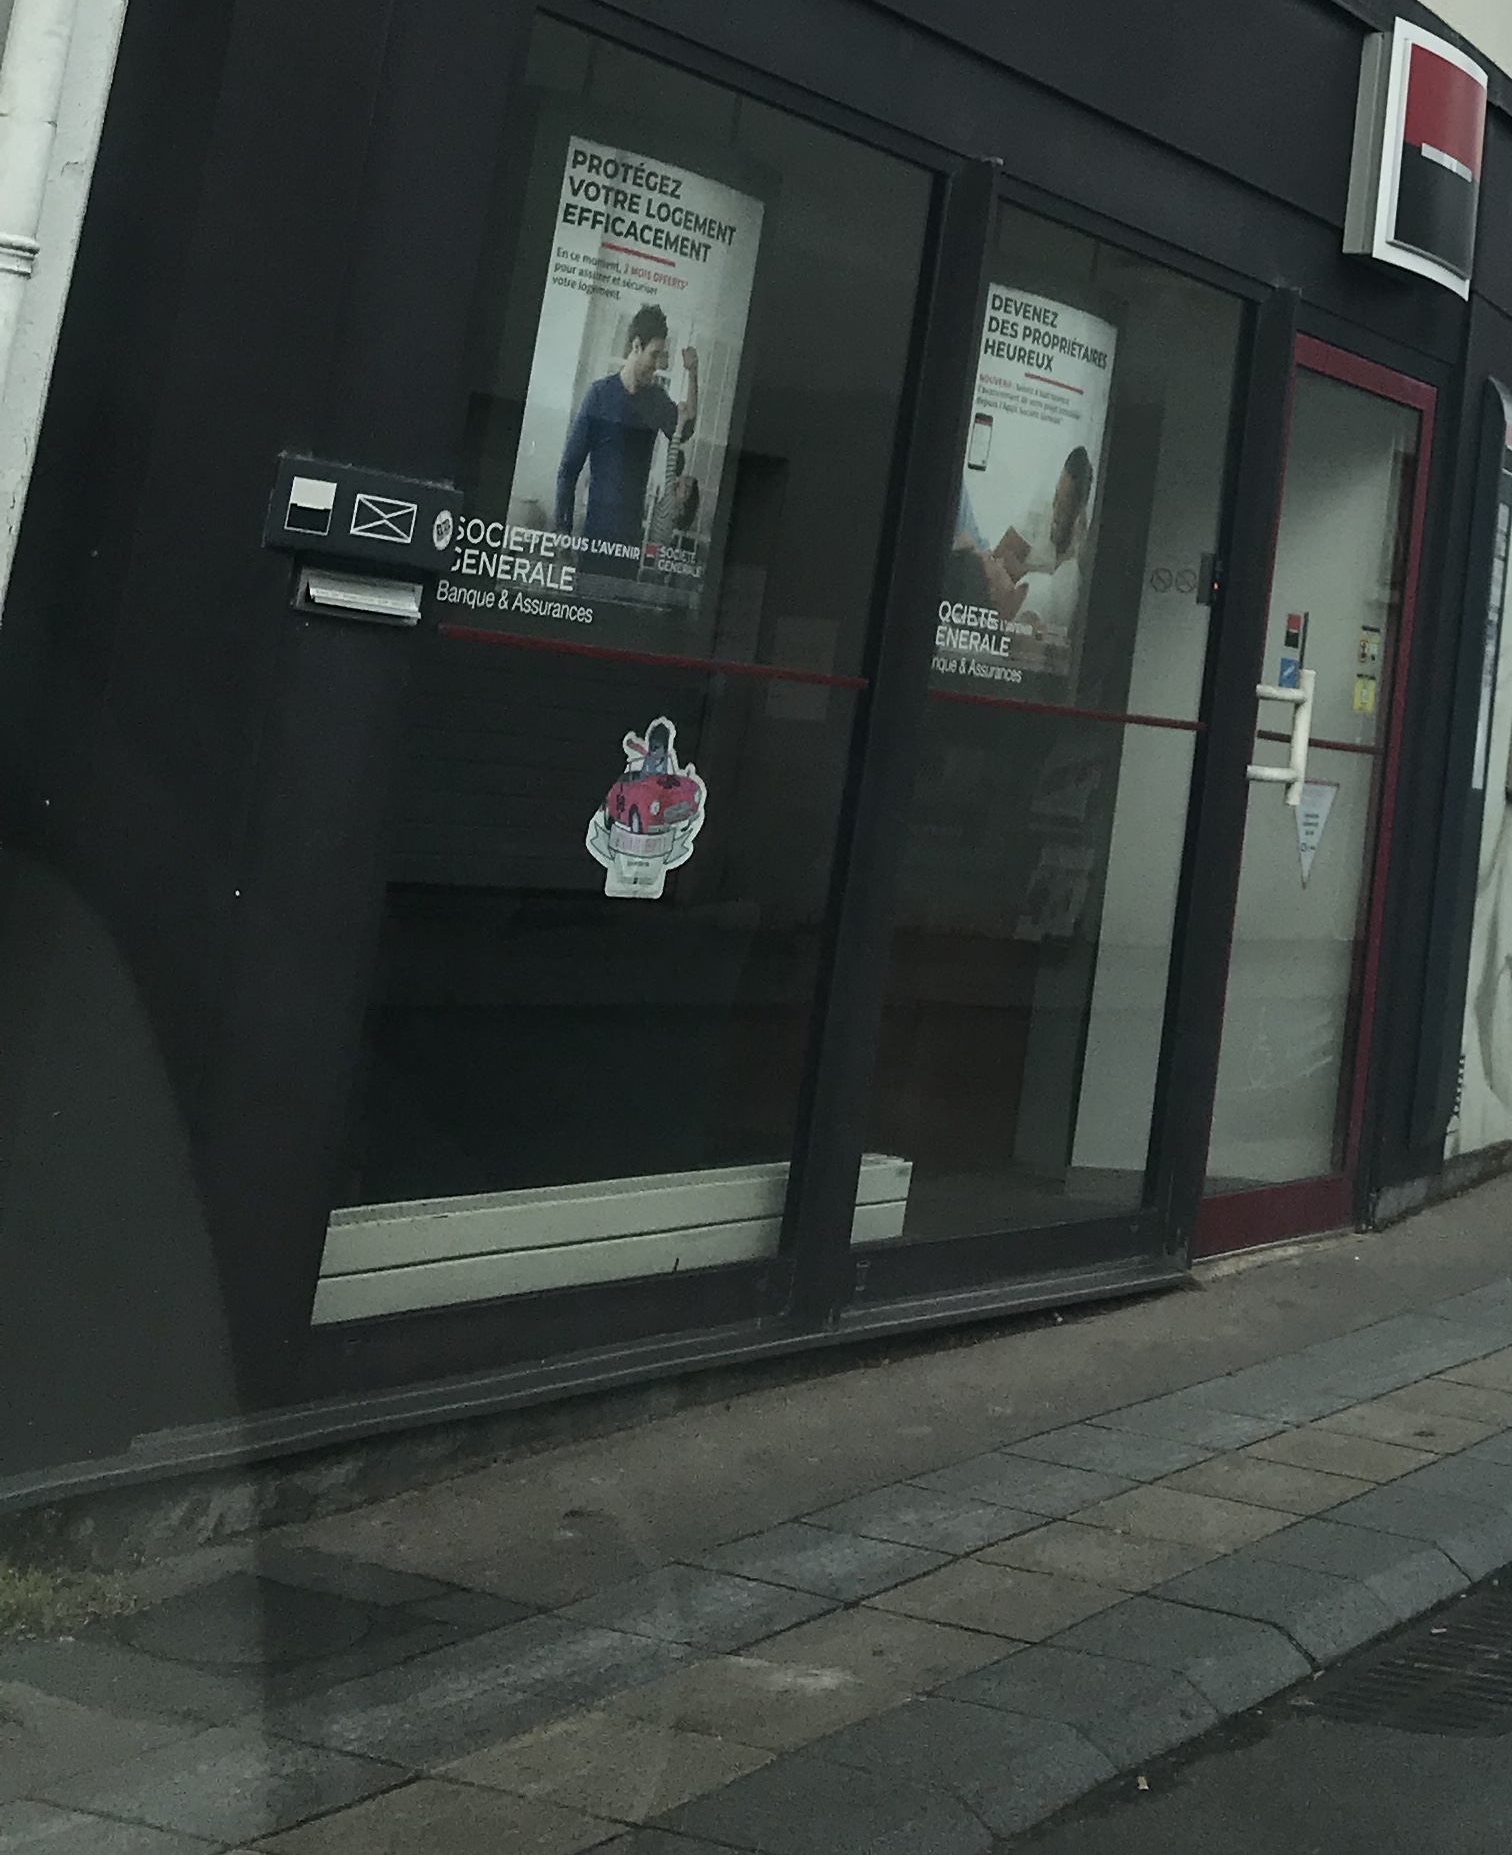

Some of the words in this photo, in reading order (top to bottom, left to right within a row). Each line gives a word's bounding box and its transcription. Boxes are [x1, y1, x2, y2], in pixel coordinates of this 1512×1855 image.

[571, 148, 684, 200] PROTÉGEZ
[568, 176, 642, 215] VOTRE
[645, 197, 737, 247] LOGEMENT
[561, 202, 712, 264] EFFICACEMENT
[991, 293, 1059, 329] DEVENEZ
[983, 338, 1055, 372] HEUREUX
[987, 315, 1019, 339] DES
[1022, 325, 1108, 370] PROPRIÉTAIRES
[590, 538, 641, 561] L'AVENIR
[436, 579, 496, 611] Banque
[498, 588, 510, 611] &
[511, 591, 594, 625] Assurances
[938, 600, 999, 631] OCIETE
[935, 625, 1012, 657] ENERALE
[967, 658, 1023, 684] Assurances
